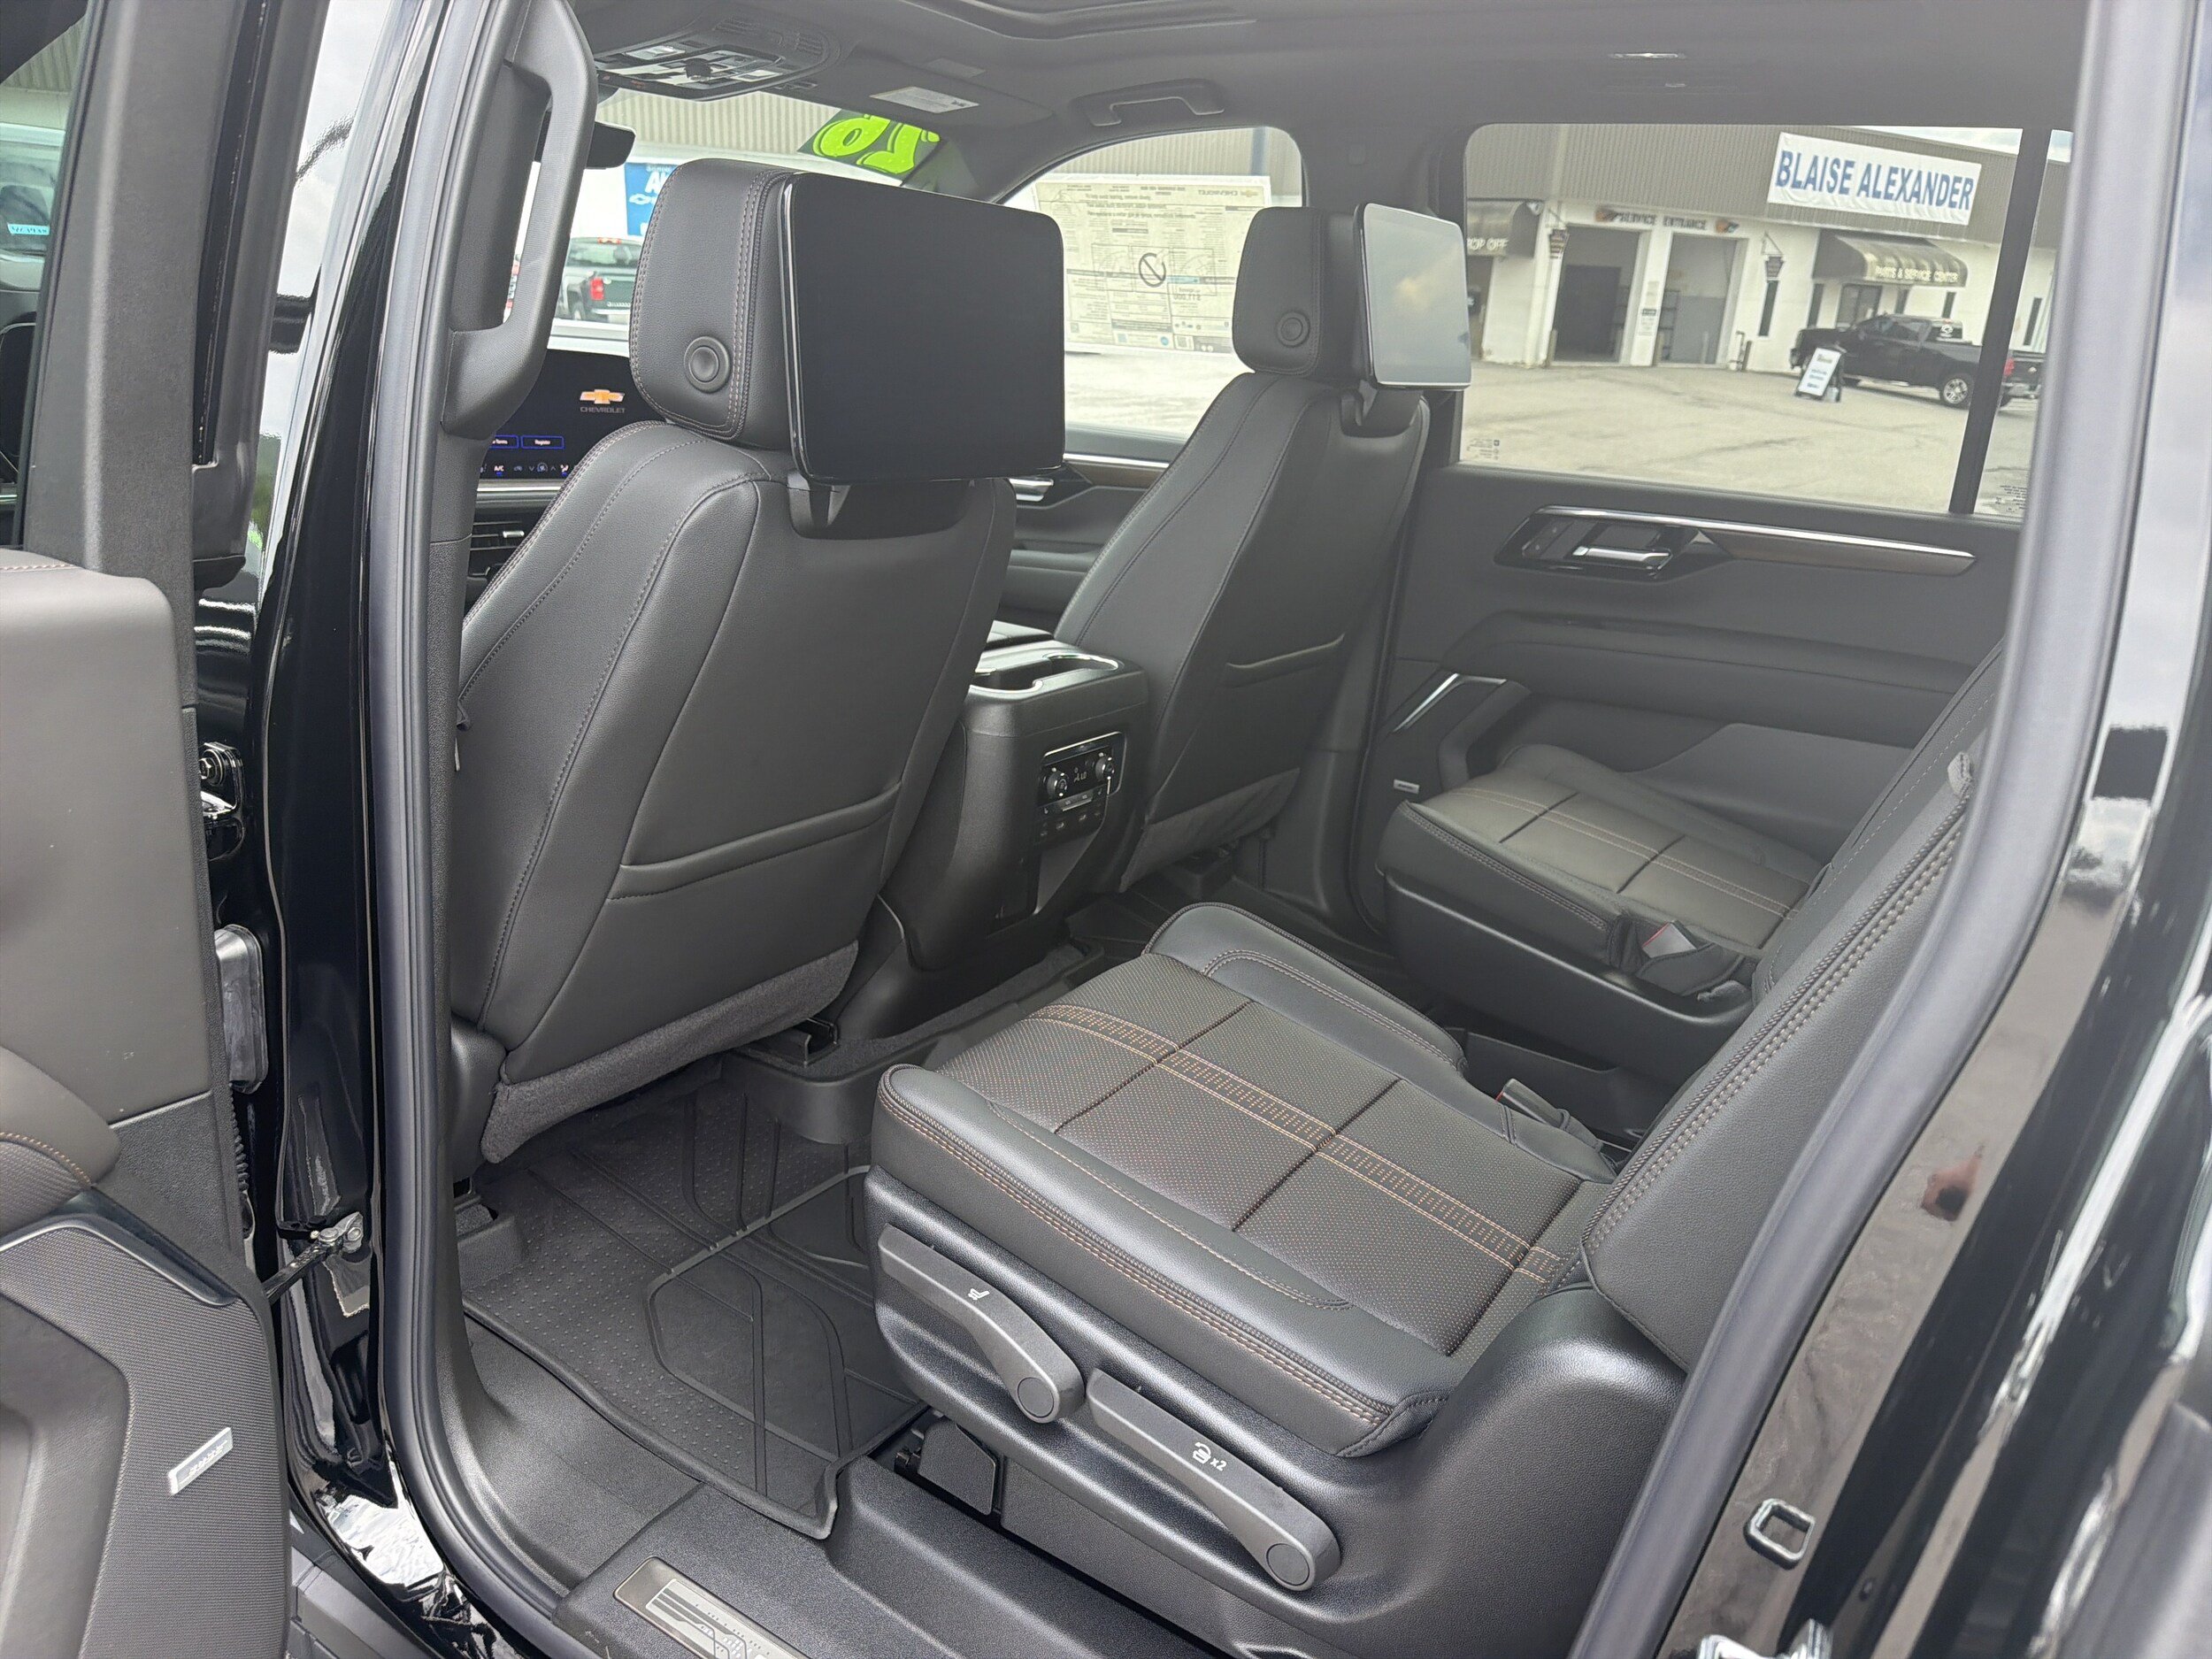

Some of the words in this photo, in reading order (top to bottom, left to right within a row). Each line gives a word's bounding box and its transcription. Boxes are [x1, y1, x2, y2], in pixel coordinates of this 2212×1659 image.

[1776, 150, 1855, 196] BLAISE
[1857, 163, 1975, 211] ALEXANDER
[1875, 265, 1897, 279] PARTS
[1897, 268, 1903, 279] &
[1904, 268, 1932, 281] SERVICE
[1933, 271, 1958, 283] CENTER
[1210, 1457, 1227, 1471] x2
